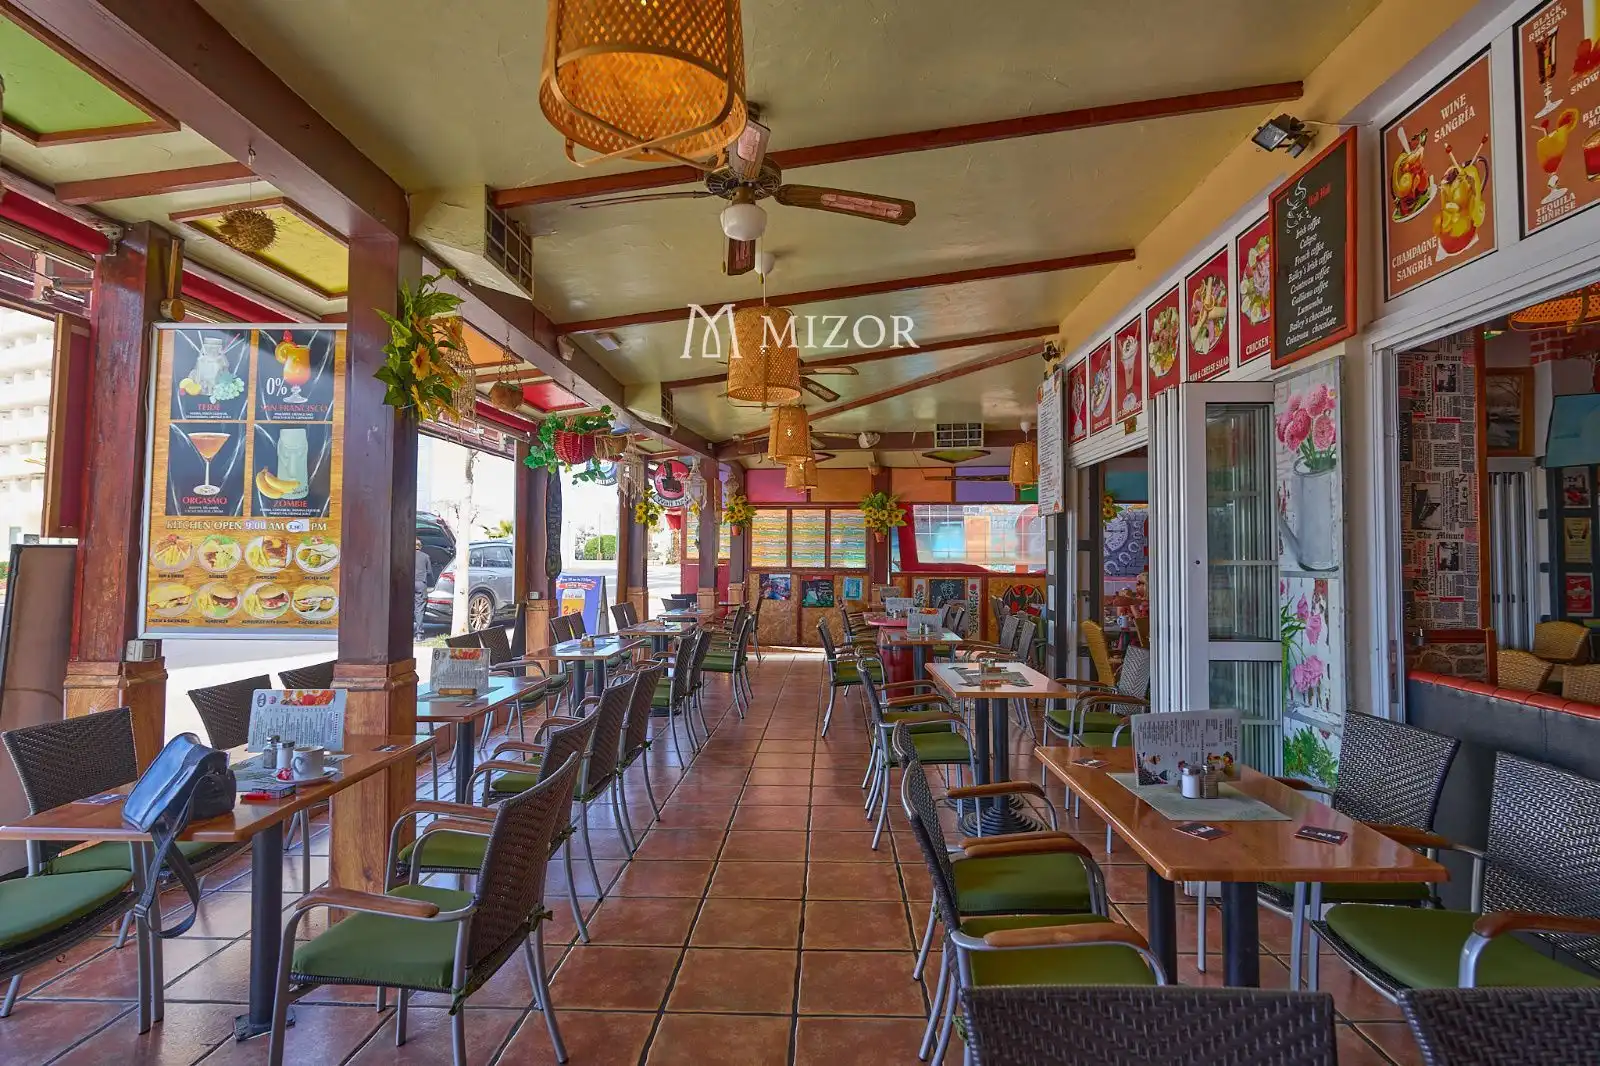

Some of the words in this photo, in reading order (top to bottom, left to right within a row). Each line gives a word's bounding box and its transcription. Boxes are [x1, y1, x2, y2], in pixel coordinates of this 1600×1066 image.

[1528, 8, 1568, 42] RUSSIAN
[1533, 3, 1562, 30] BLACK
[1440, 93, 1466, 120] WINE
[1433, 105, 1476, 143] SANGRÍA
[1536, 193, 1576, 216] TEQUILA
[1536, 201, 1577, 226] SUNRISE
[1307, 216, 1321, 232] coffee
[1311, 241, 1325, 257] coffee
[1318, 250, 1333, 266] coffee
[1392, 235, 1437, 269] CHAMPAGNE
[1315, 265, 1330, 281] coffee
[1396, 254, 1433, 282] SANGRÍA
[1313, 280, 1329, 295] coffee
[1246, 336, 1268, 356] CHICKEN
[266, 377, 288, 397] 0%
[278, 403, 328, 413] FRANCISCO
[182, 496, 229, 505] ORGASMO
[273, 500, 309, 508] ZOMBIE
[166, 520, 211, 530] KITCHEN
[213, 520, 242, 530] OPEN
[268, 522, 285, 531] AM
[311, 522, 328, 531] PM
